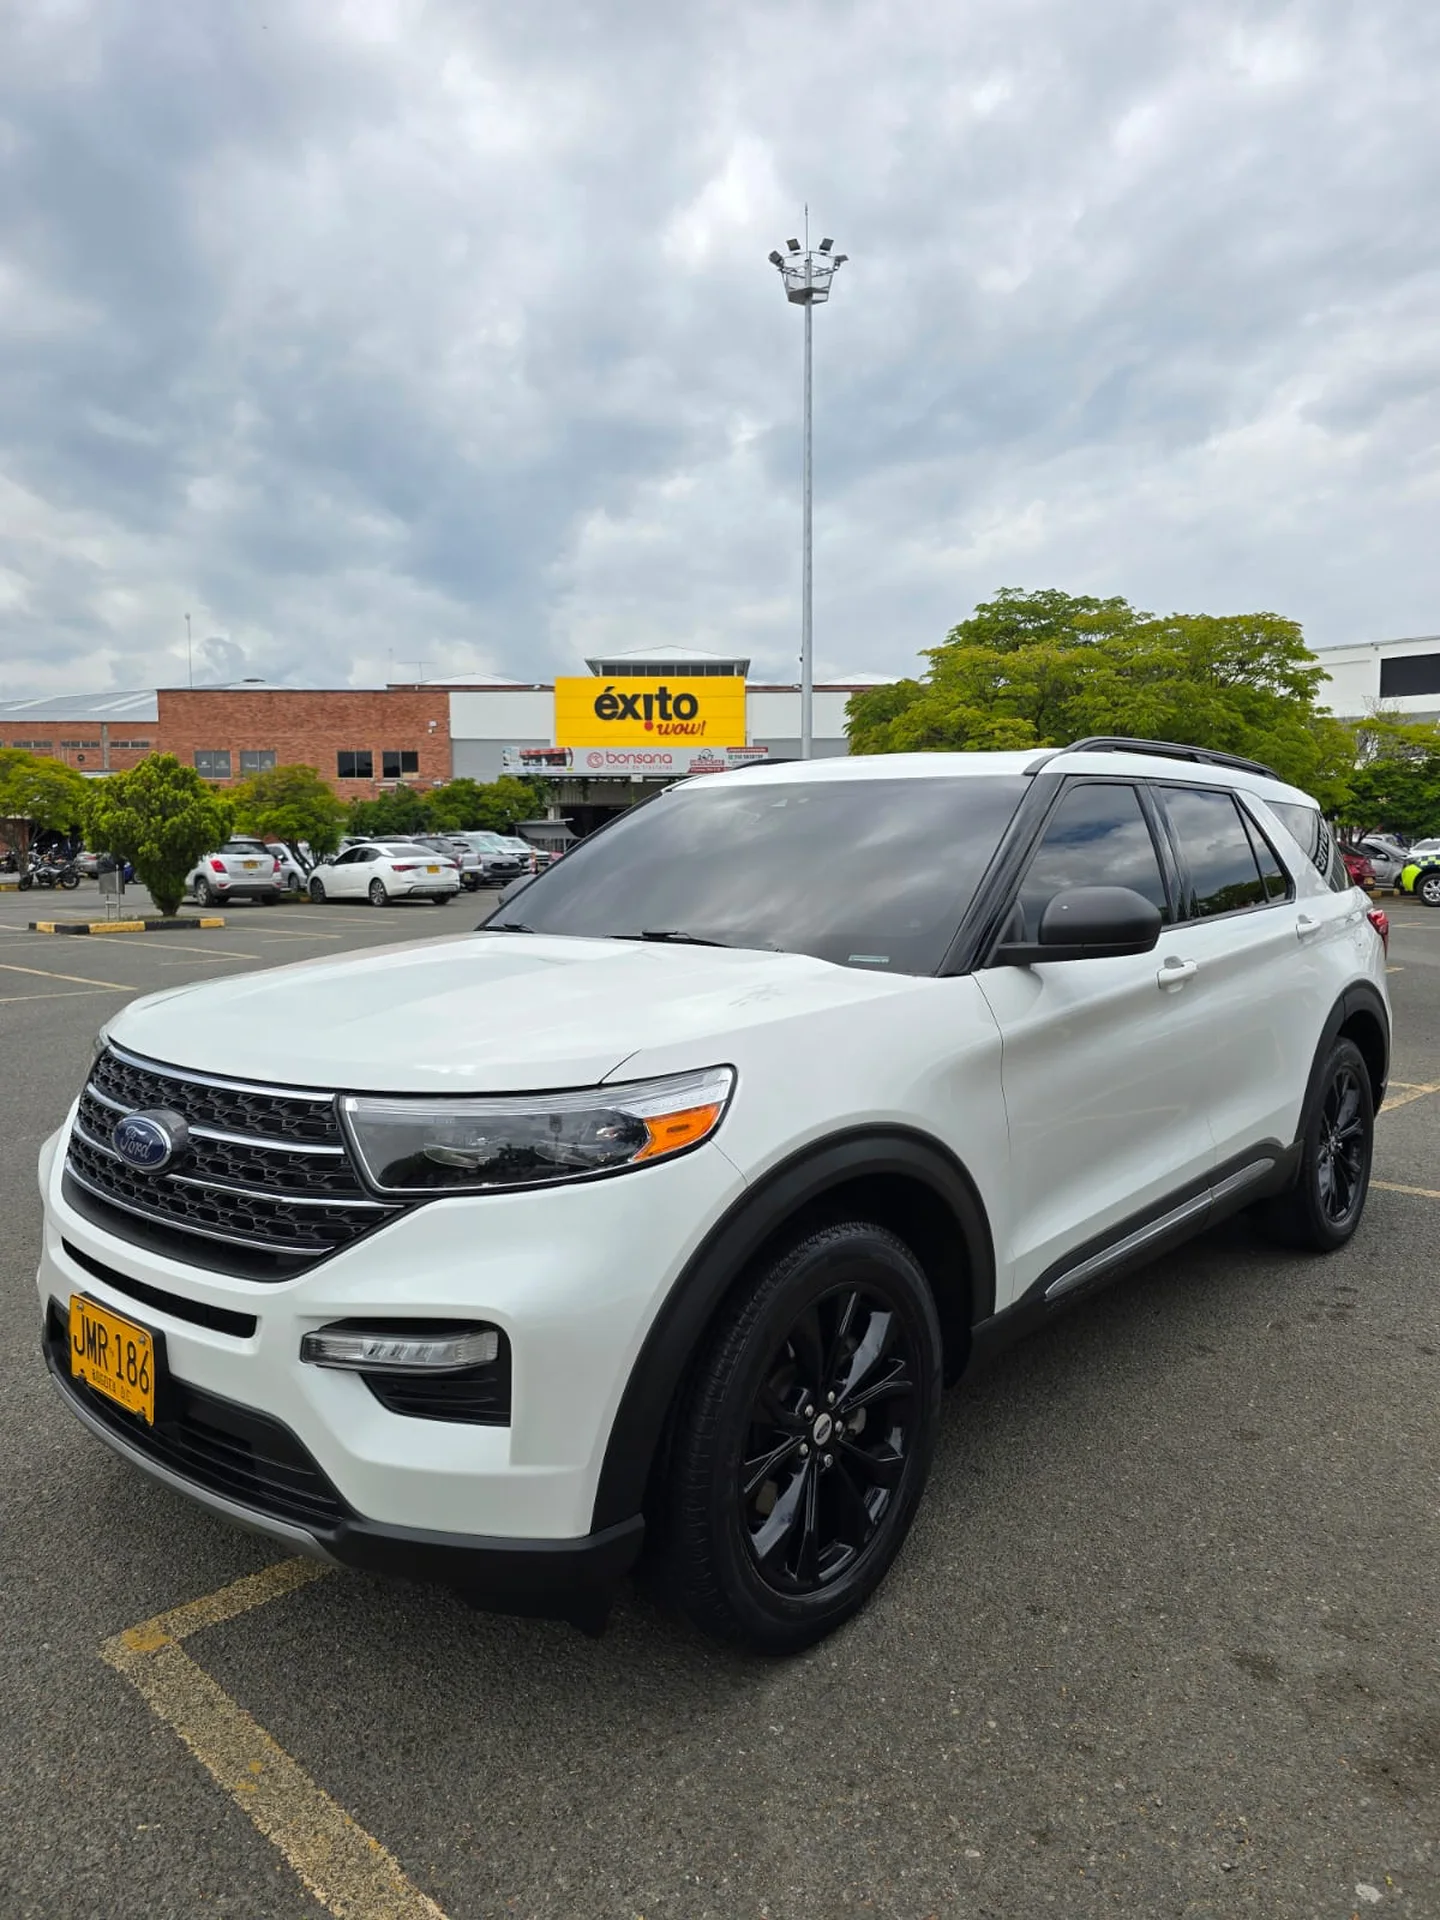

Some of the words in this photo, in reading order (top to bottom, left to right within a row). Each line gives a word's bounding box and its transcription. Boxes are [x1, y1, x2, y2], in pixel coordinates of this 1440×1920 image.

[594, 686, 699, 731] éxito
[656, 720, 706, 736] wow!
[605, 751, 672, 764] bonsana
[120, 1126, 153, 1159] Ford
[74, 1313, 108, 1371] JMR
[114, 1333, 149, 1395] 186
